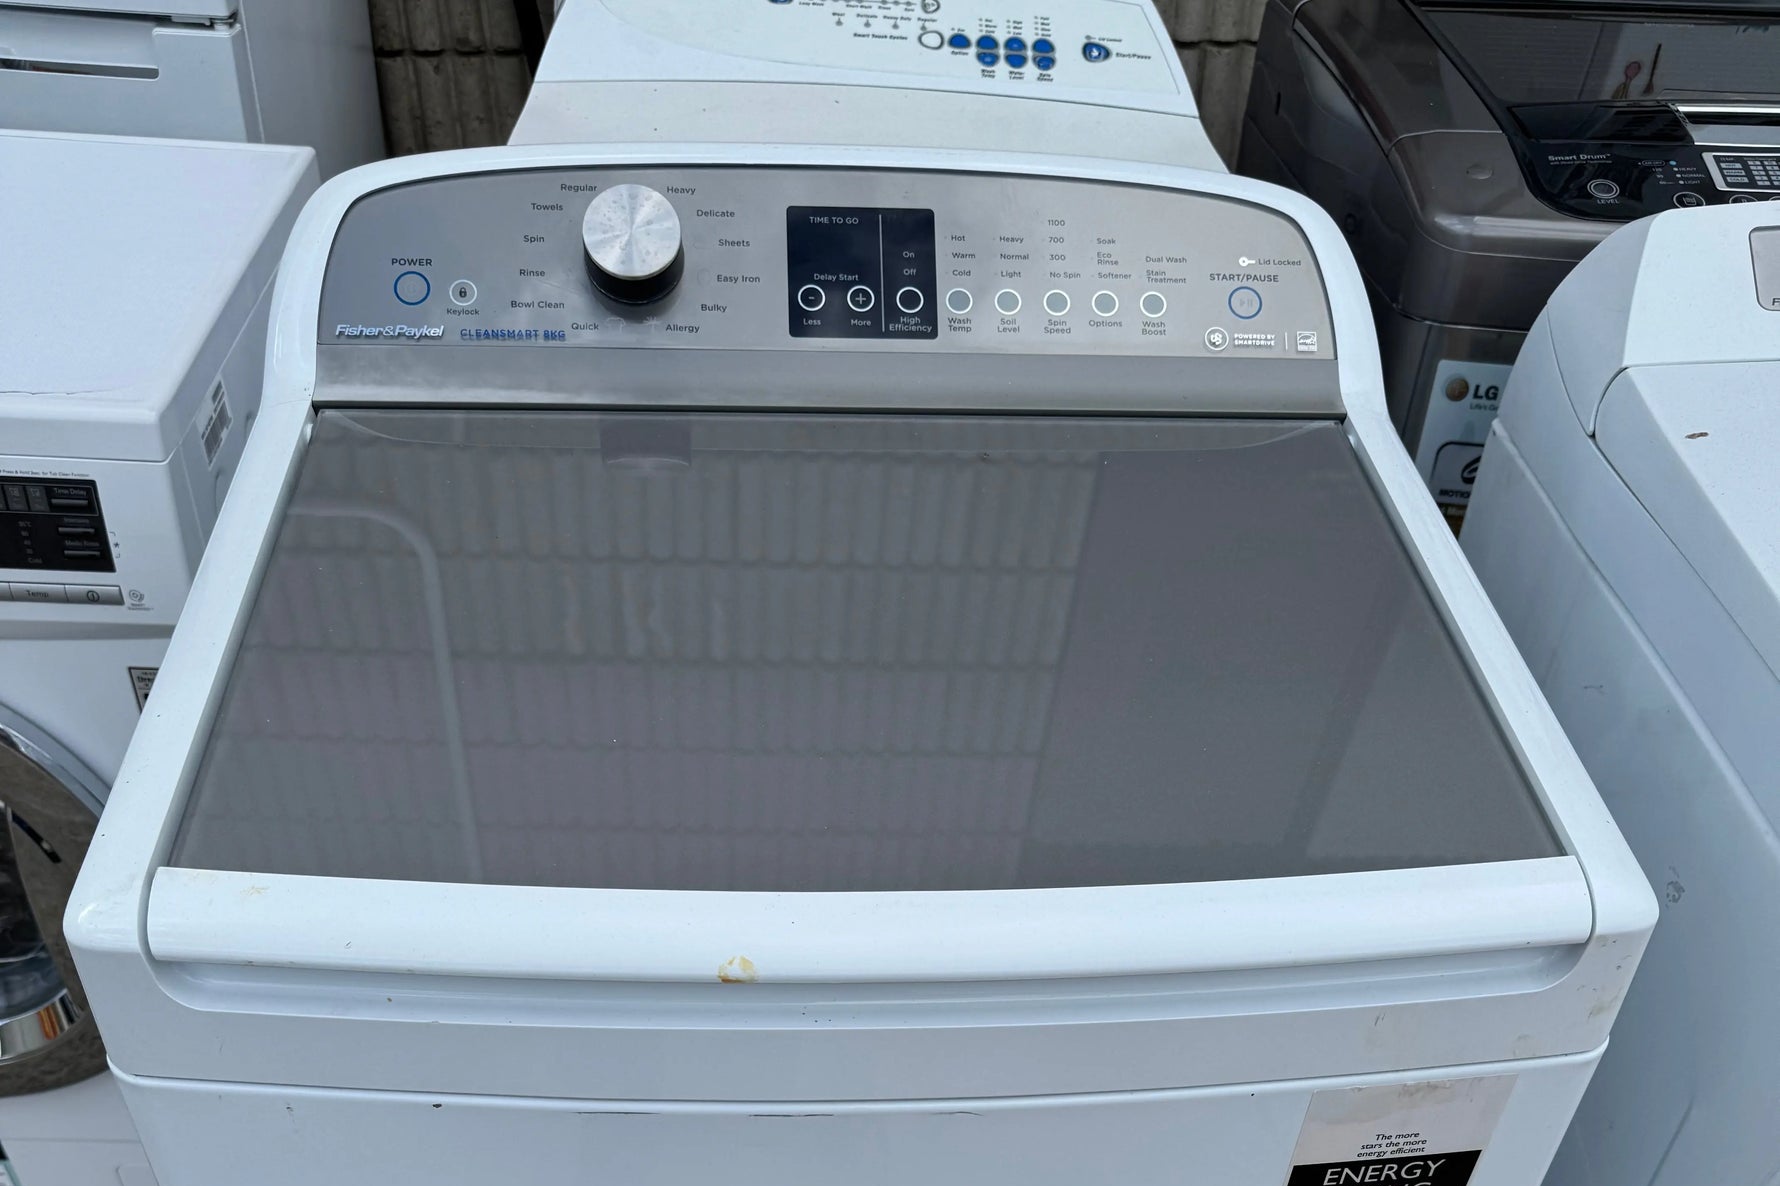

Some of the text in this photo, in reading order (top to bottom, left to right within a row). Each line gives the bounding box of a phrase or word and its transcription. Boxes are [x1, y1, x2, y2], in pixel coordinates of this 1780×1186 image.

[560, 183, 597, 193] Regular
[667, 186, 695, 196] Heavy
[531, 203, 563, 211] Towels
[696, 209, 735, 218] Delicate
[809, 216, 829, 224] TIME
[1048, 219, 1065, 227] 1100
[523, 235, 544, 244] Spin
[718, 239, 750, 247] Sheets
[999, 235, 1024, 244] Heavy
[1048, 236, 1064, 244] 700
[1096, 237, 1116, 245] Soak
[1000, 253, 1029, 261] Normal
[1146, 256, 1163, 264] Dual
[391, 258, 432, 266] POWER
[1273, 258, 1301, 267] Locked
[520, 269, 545, 277] Rinse
[903, 268, 917, 276] Off
[952, 269, 971, 277] Cold
[1001, 270, 1022, 279] Light
[1064, 271, 1081, 280] Spin
[1097, 272, 1132, 280] Softener
[717, 275, 760, 284] Easy Iron
[814, 273, 836, 282] Delay
[1209, 273, 1279, 282] START/PAUSE
[511, 301, 565, 309] Bowl Clean
[701, 304, 727, 313] Bulky
[447, 308, 480, 317] Keylock
[900, 316, 920, 326] High
[948, 317, 972, 325] Wash
[1000, 318, 1016, 326] Soil
[1048, 319, 1067, 328] Spin
[1088, 319, 1123, 328] Options
[1142, 320, 1166, 328] Wash
[571, 323, 599, 331] Quick
[666, 324, 700, 334] Allergy
[889, 323, 932, 333] Efficiency
[949, 325, 972, 333] Temp
[1044, 326, 1071, 335] Speed
[460, 329, 566, 341] CLEANSMART 8KG
[1142, 328, 1167, 336] Boost
[1473, 384, 1499, 400] LG
[1438, 489, 1470, 498] MOTIO
[1394, 1132, 1420, 1140] more
[1357, 1147, 1425, 1158] energy efficient
[1323, 1158, 1447, 1186] ENERGY
